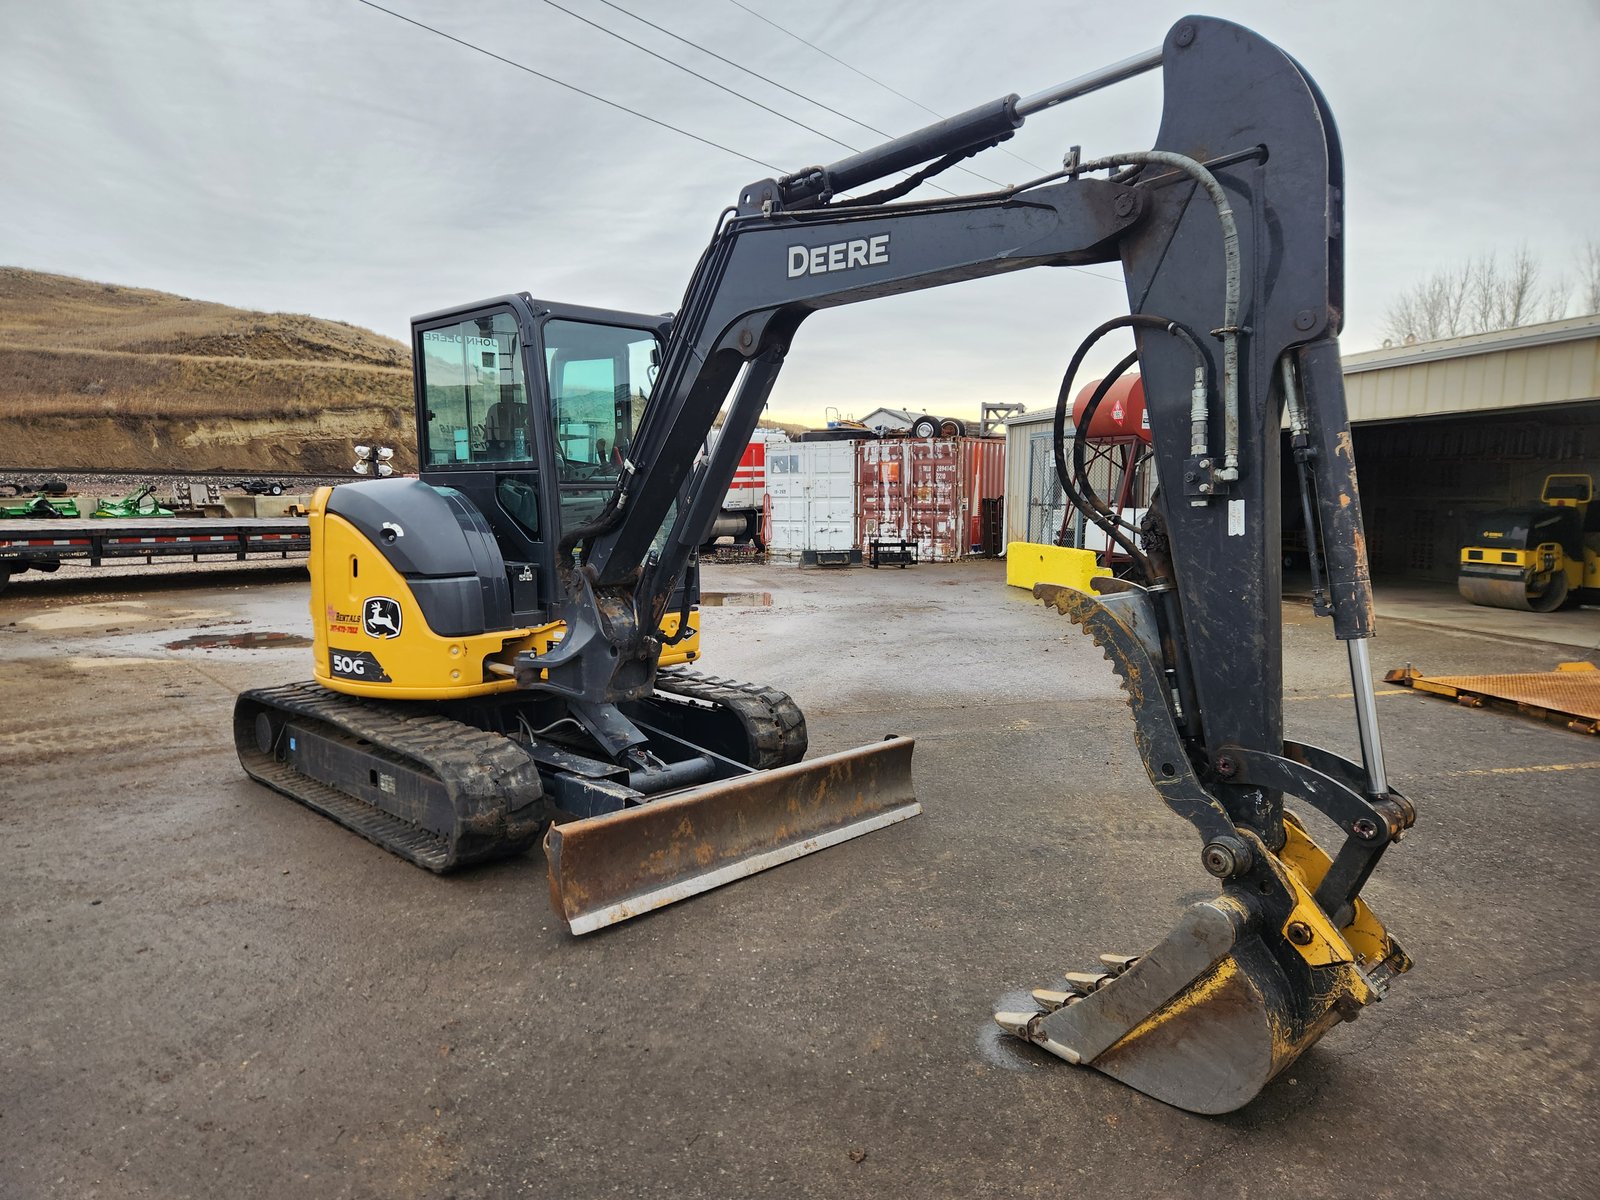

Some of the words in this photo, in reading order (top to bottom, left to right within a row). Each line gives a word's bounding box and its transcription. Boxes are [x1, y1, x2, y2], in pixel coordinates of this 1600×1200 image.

[788, 235, 889, 278] DEERE
[336, 612, 361, 623] RENTALS
[334, 655, 365, 675] 50G
